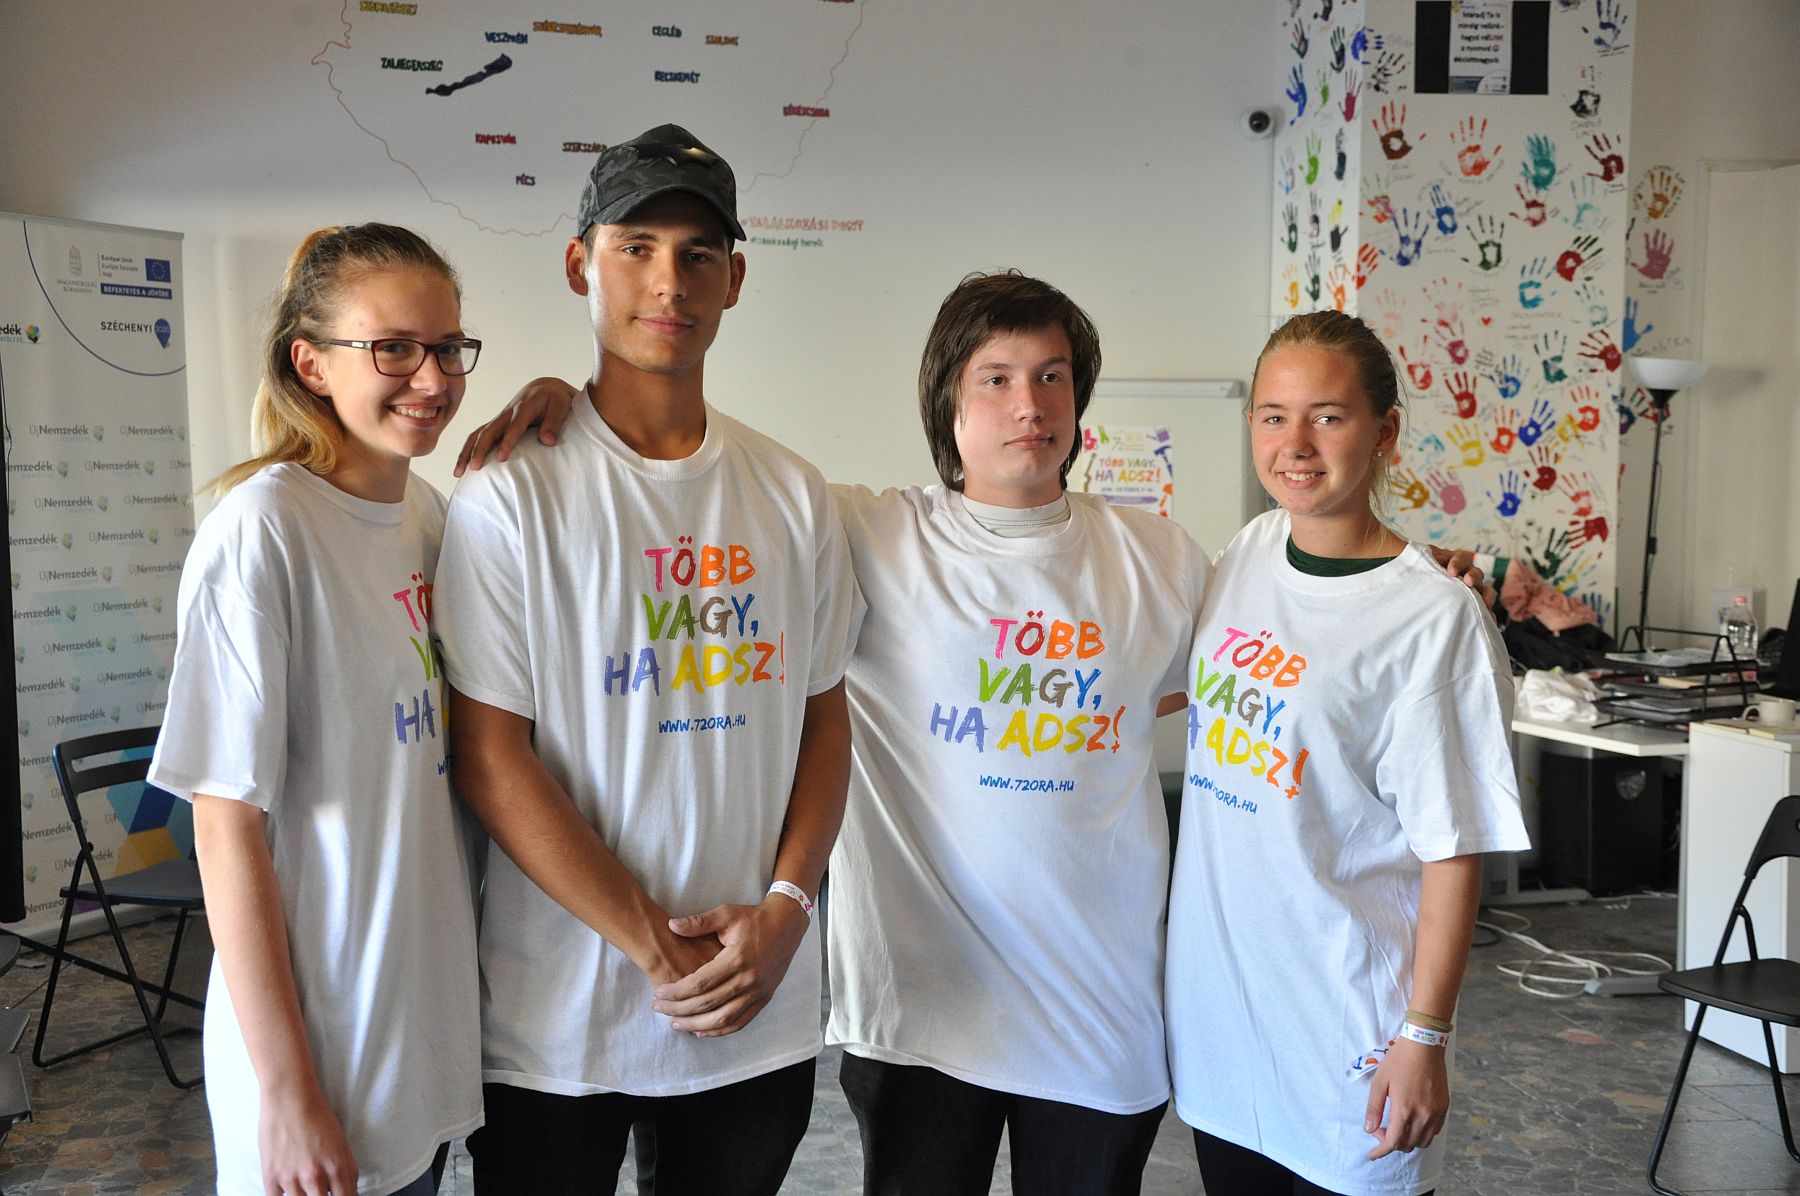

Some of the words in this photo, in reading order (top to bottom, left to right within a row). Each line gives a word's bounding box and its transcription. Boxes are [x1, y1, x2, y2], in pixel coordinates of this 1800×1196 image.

[516, 173, 536, 187] PÉCS
[141, 288, 146, 296] A
[100, 319, 152, 333] SZÉCHENYI
[1095, 469, 1114, 482] HA
[644, 535, 756, 592] TÖBB
[642, 593, 759, 641] VAGY,
[989, 610, 1105, 660] TÖBB
[604, 646, 662, 696] HA
[670, 631, 785, 694] ADSZ!
[1213, 627, 1307, 687] TÖBB
[978, 658, 1102, 710] VAGY,
[1195, 656, 1286, 741] VAGY,
[395, 688, 436, 744] HA
[930, 702, 989, 753] HA
[996, 705, 1127, 757] ADSZ!
[1206, 717, 1310, 800] ADSZ!
